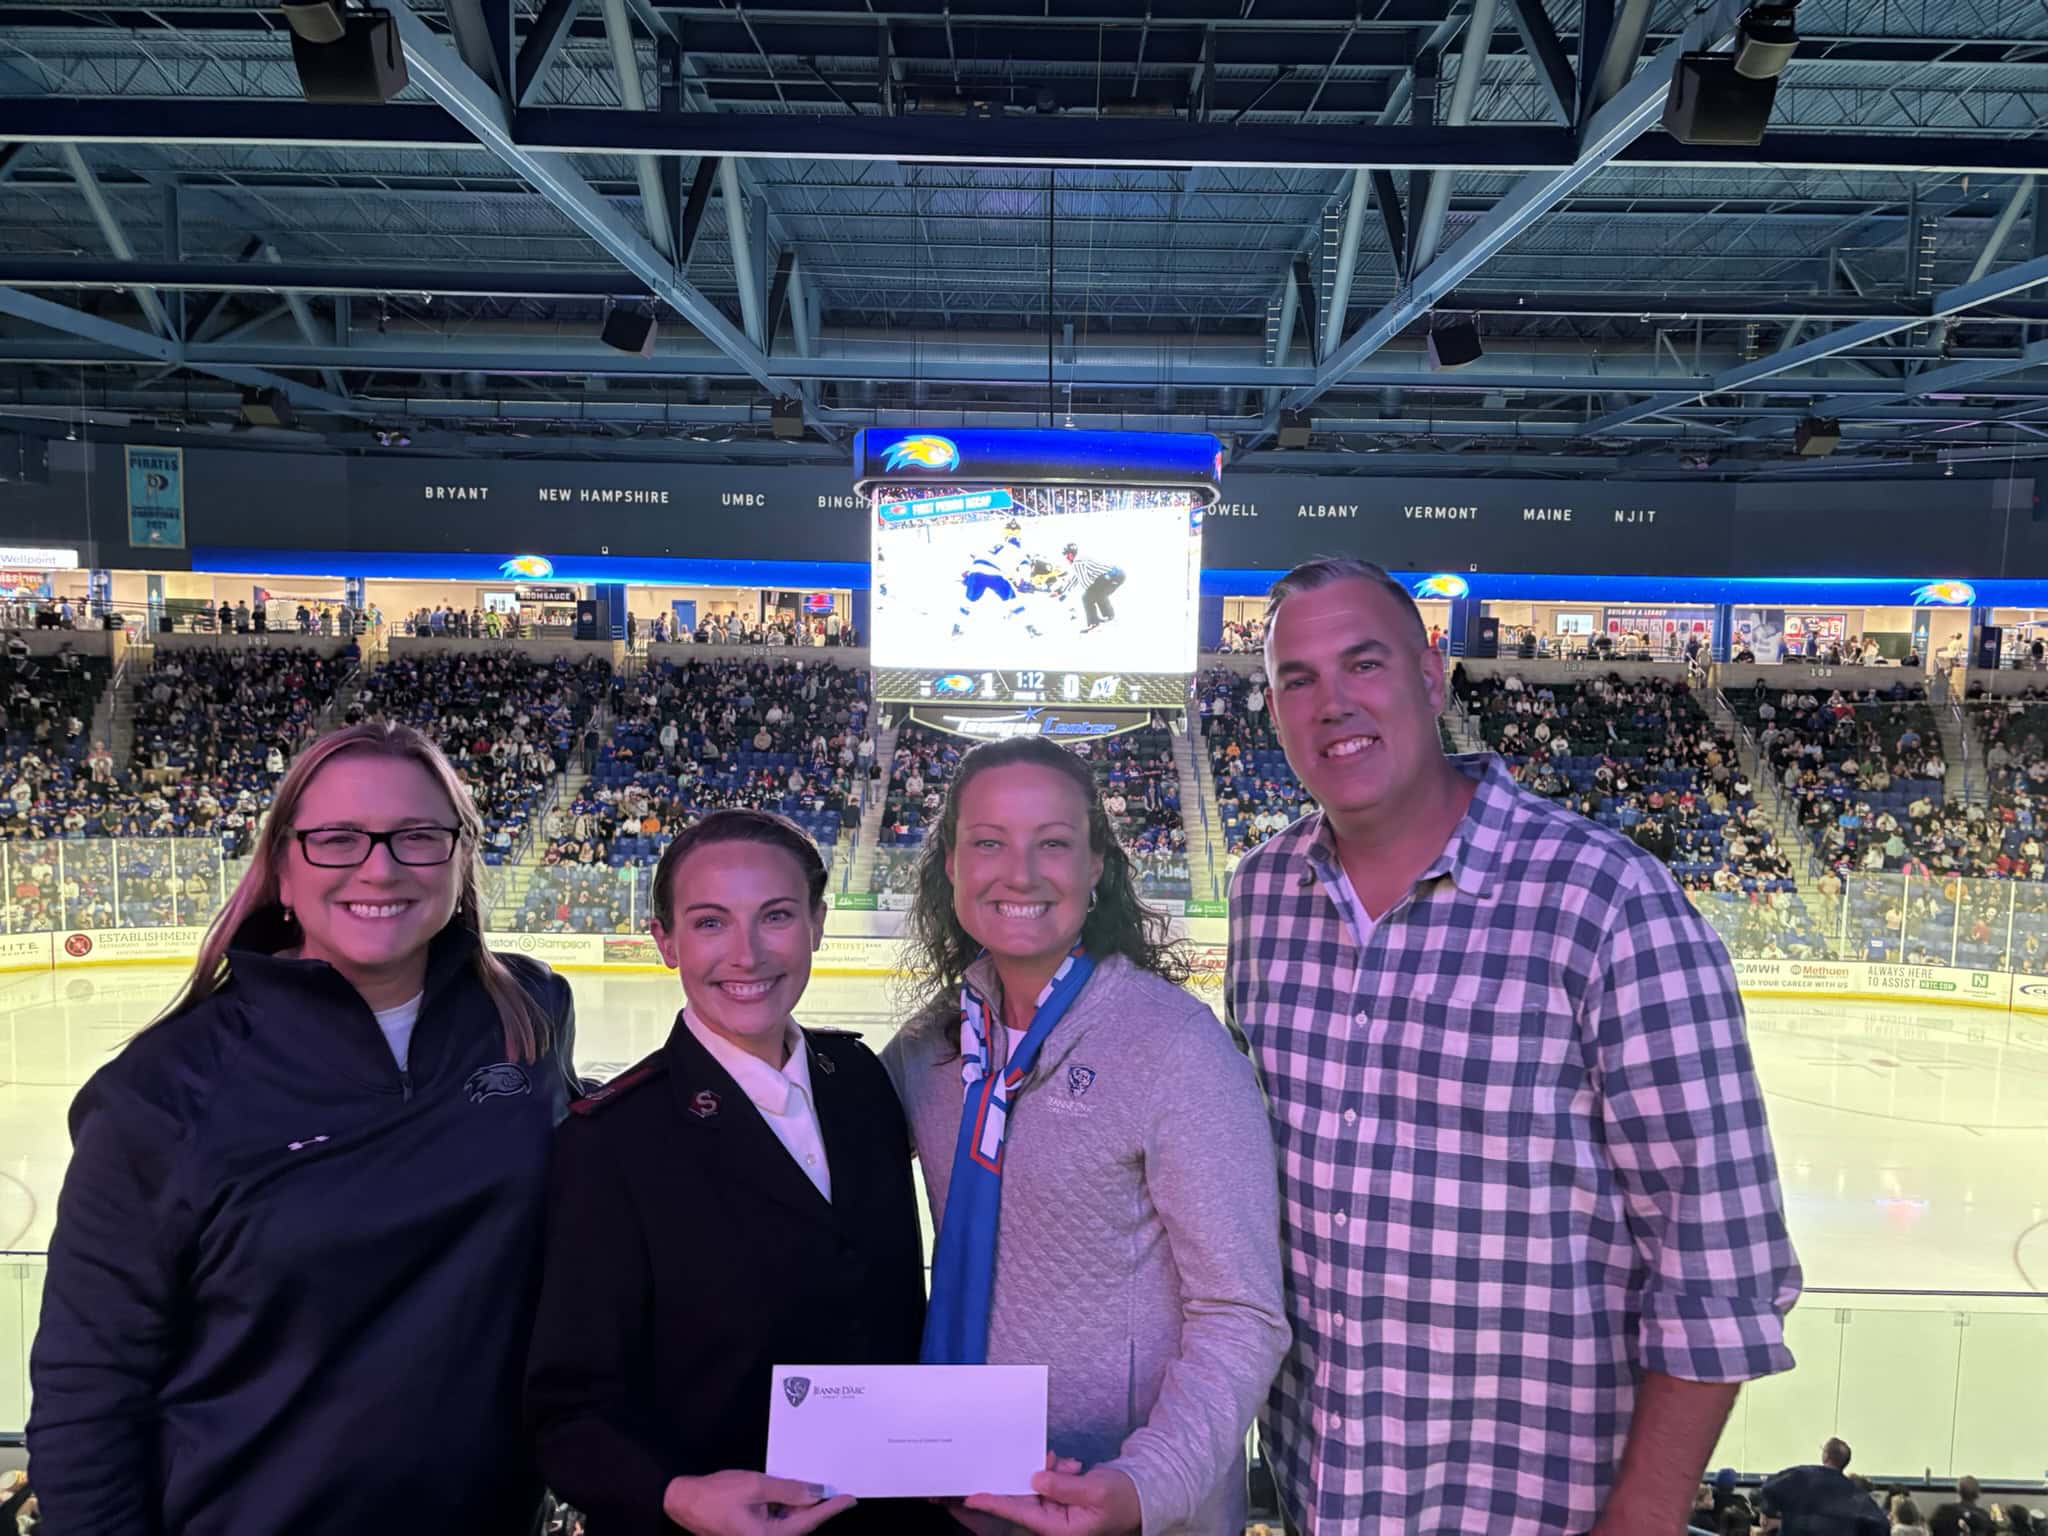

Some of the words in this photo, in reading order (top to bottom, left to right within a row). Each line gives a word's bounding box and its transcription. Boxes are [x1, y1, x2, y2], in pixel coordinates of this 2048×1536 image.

[130, 457, 178, 471] PIRATES
[424, 486, 489, 499] BRYANT
[539, 488, 572, 501] NEW
[580, 489, 670, 504] HAMPSHIRE
[721, 493, 766, 507] UMBC
[1206, 503, 1258, 517] OWELL
[1297, 504, 1359, 518] ALBANY
[1404, 506, 1479, 519] VERMONT
[1523, 508, 1573, 521] MAINE
[1615, 510, 1656, 523] NJIT
[0, 553, 56, 565] Wellpoint
[1015, 671, 1045, 689] 1:12
[1063, 674, 1080, 699] 0
[1042, 716, 1117, 735] Center
[98, 931, 199, 944] ESTABLISHMENT
[536, 938, 591, 950] Sampson
[1746, 964, 1780, 975] MWH
[1803, 965, 1849, 977] Methuen
[1867, 965, 1905, 977] ALWAYS
[1908, 967, 1934, 979] HERE
[1758, 979, 1779, 987] YOUR
[1782, 980, 1813, 988] CAREER
[1815, 980, 1836, 988] WITH
[1868, 976, 1879, 987] TO
[1881, 977, 1915, 989] ASSIST
[696, 1091, 717, 1112] S
